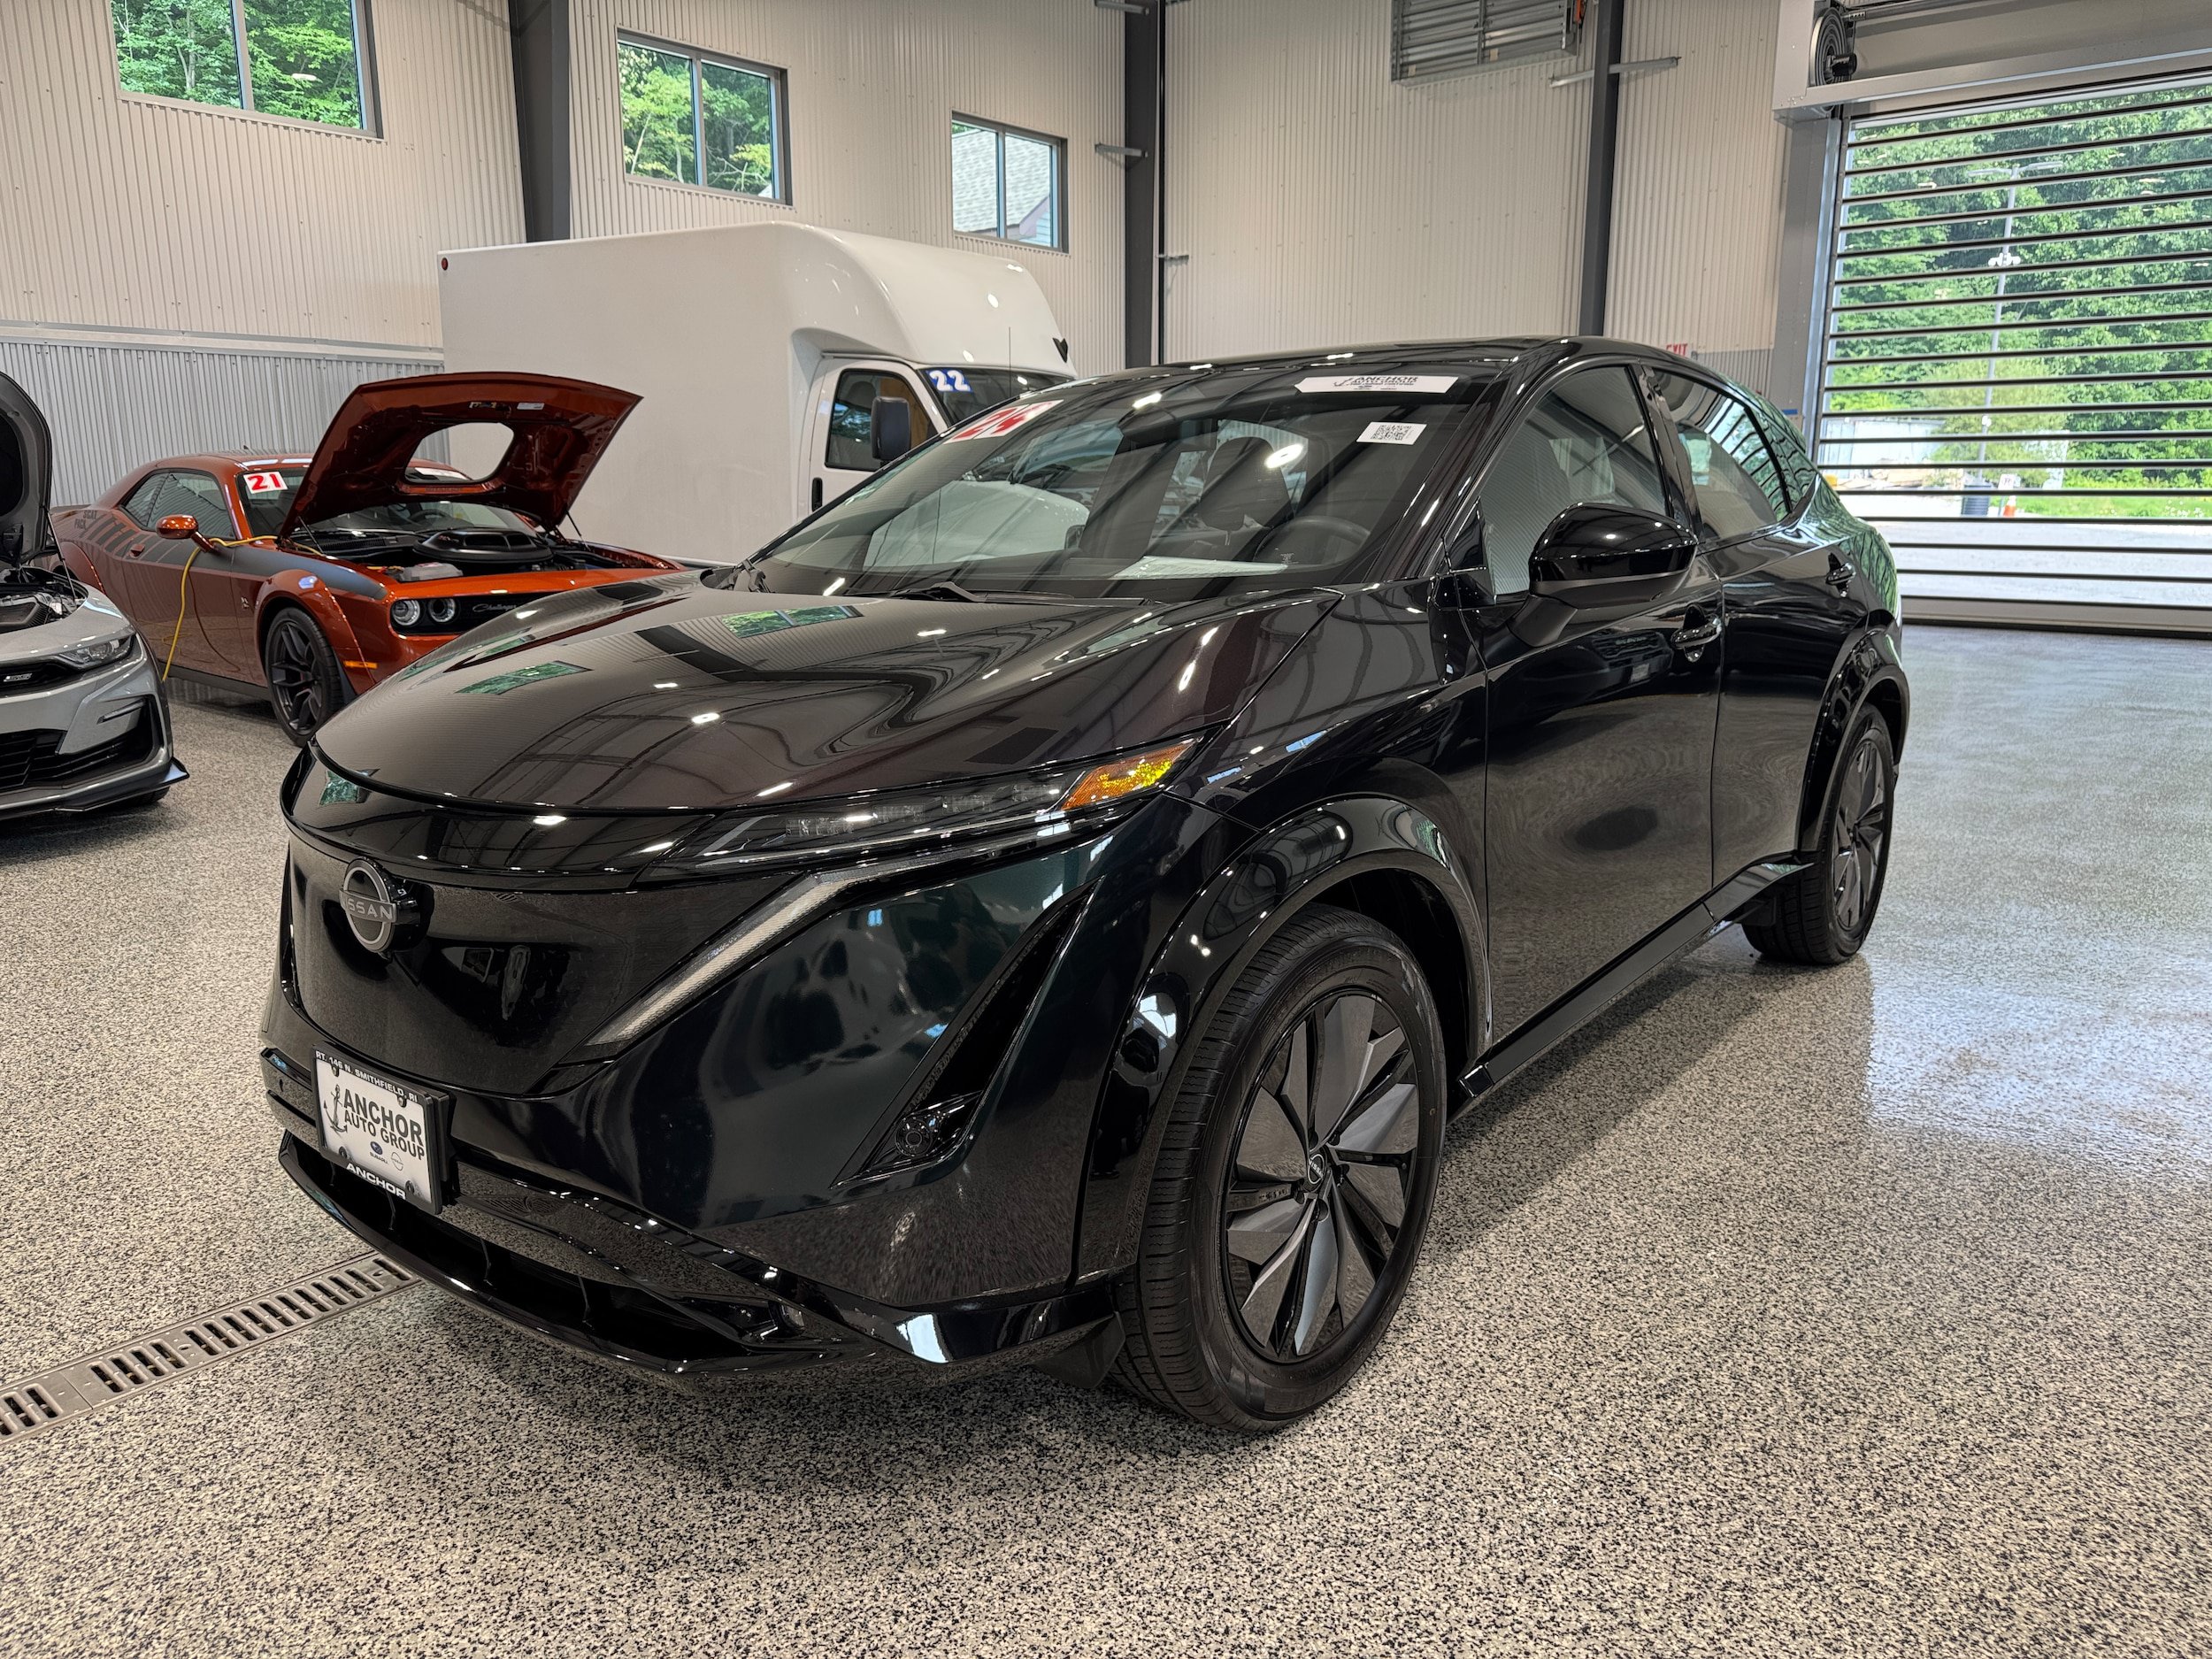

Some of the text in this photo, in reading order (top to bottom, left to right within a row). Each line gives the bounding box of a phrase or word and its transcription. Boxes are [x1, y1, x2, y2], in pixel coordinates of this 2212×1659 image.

[930, 370, 971, 391] 22
[248, 475, 280, 490] 21
[329, 1056, 343, 1069] 146
[409, 1093, 418, 1103] RI
[343, 1088, 424, 1147] ANCHOR
[344, 1110, 425, 1160] AUTO GROUP
[346, 1163, 406, 1200] ANCHOR
